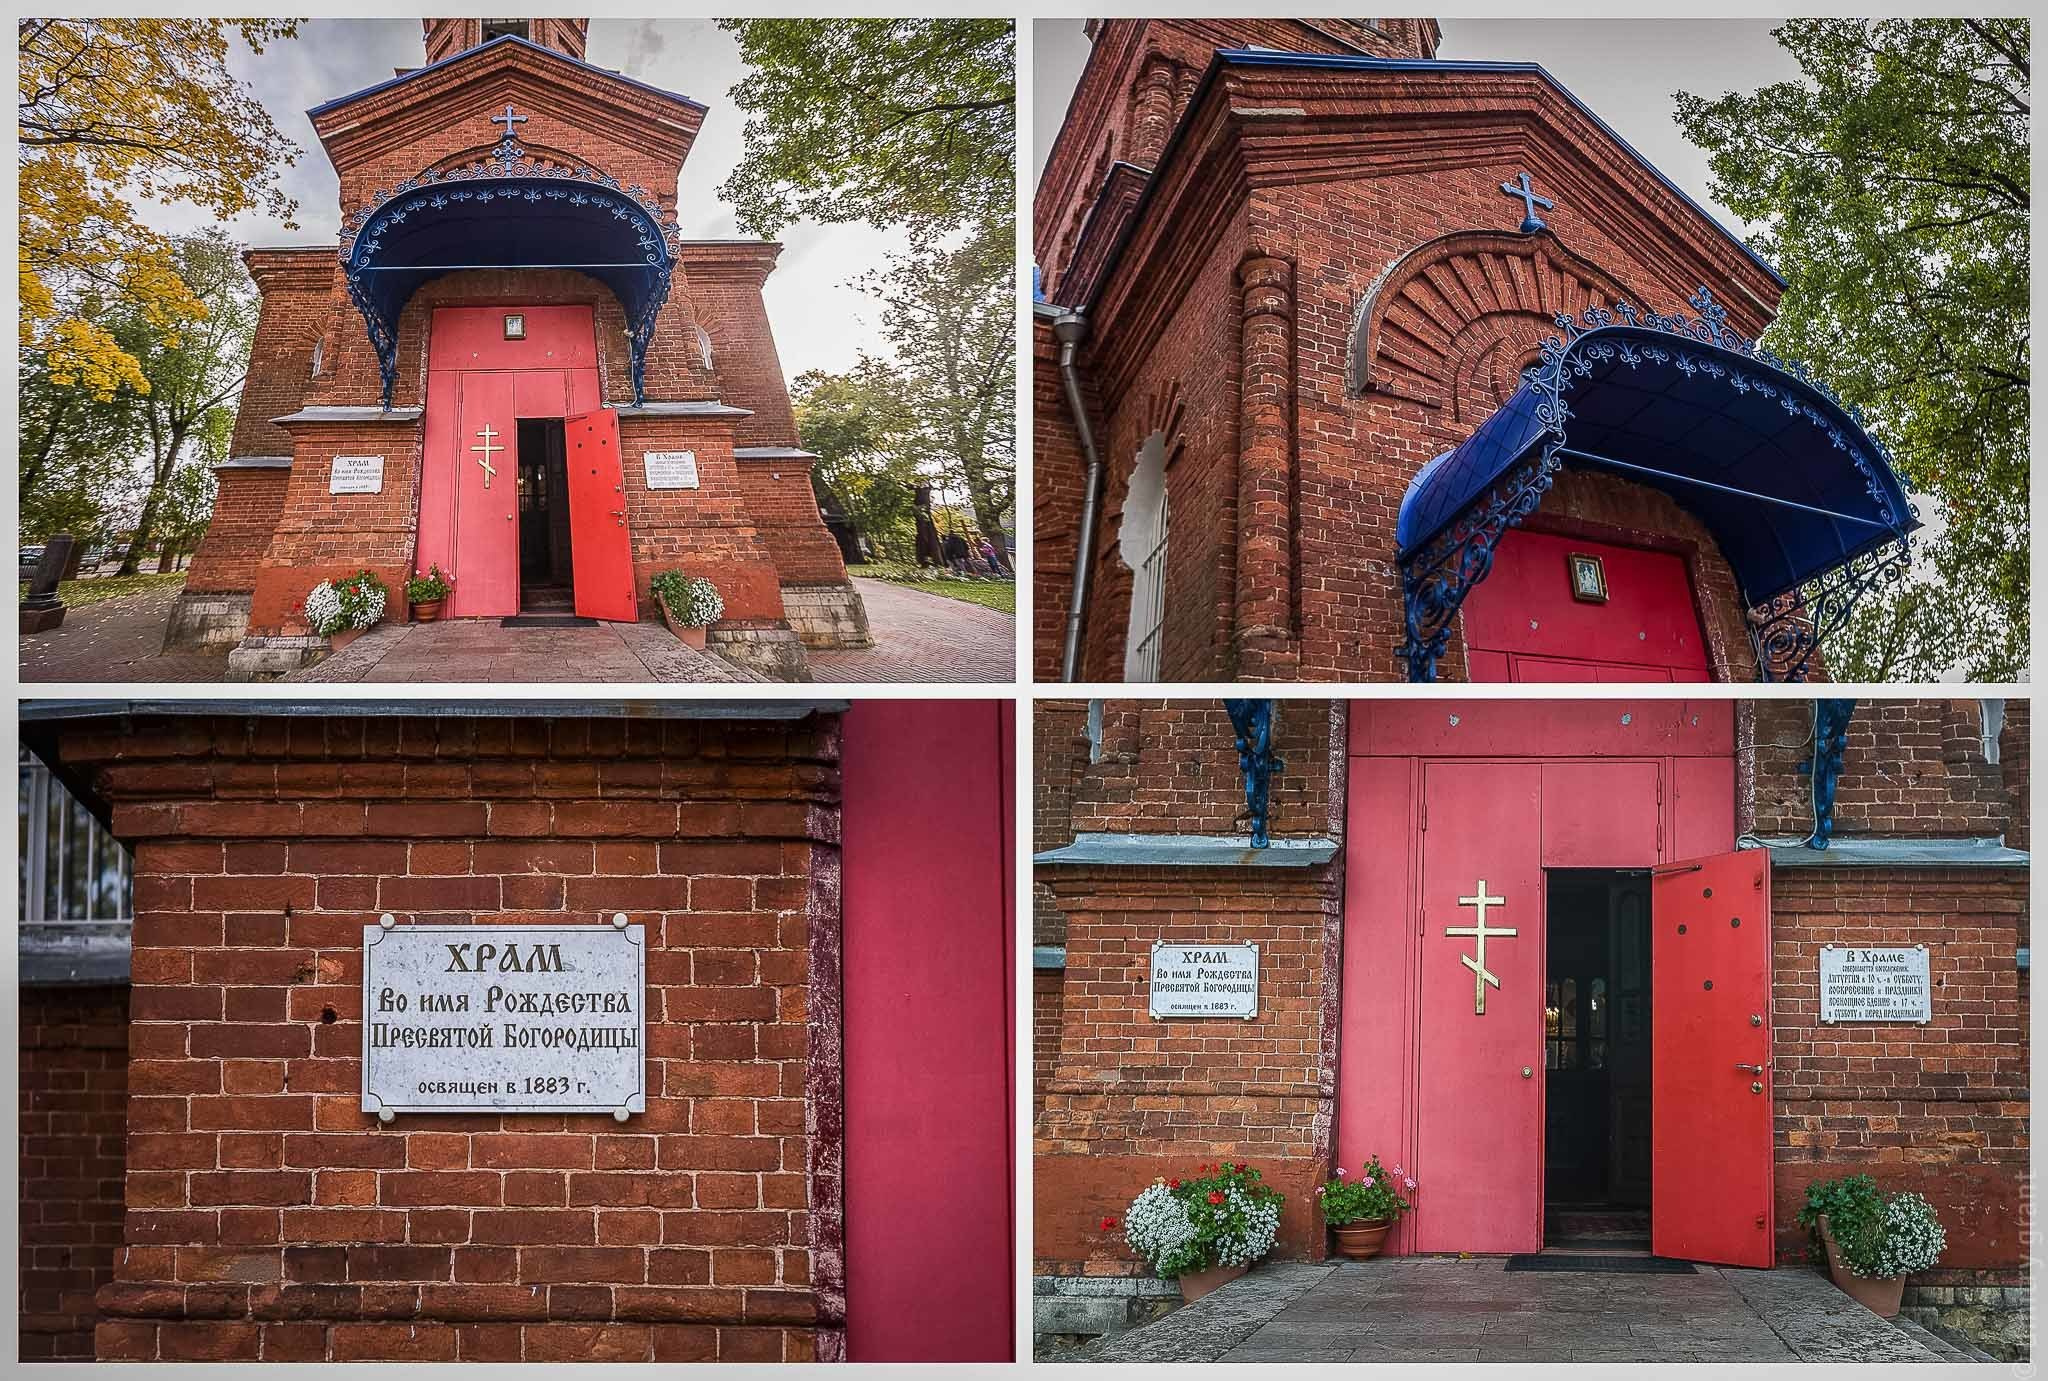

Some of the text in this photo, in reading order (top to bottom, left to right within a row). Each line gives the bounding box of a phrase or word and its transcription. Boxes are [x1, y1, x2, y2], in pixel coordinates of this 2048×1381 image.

[444, 943, 566, 973] ХРАМ
[1182, 951, 1229, 964] ХРАМ
[1846, 950, 1905, 966] В Храме
[1156, 967, 1168, 979] Во
[1172, 970, 1191, 979] имя
[377, 985, 632, 1017] Во имя Рождества
[372, 1023, 638, 1054] Пресвятой Богородицы
[418, 1076, 591, 1097] освящен в 1883 г.
